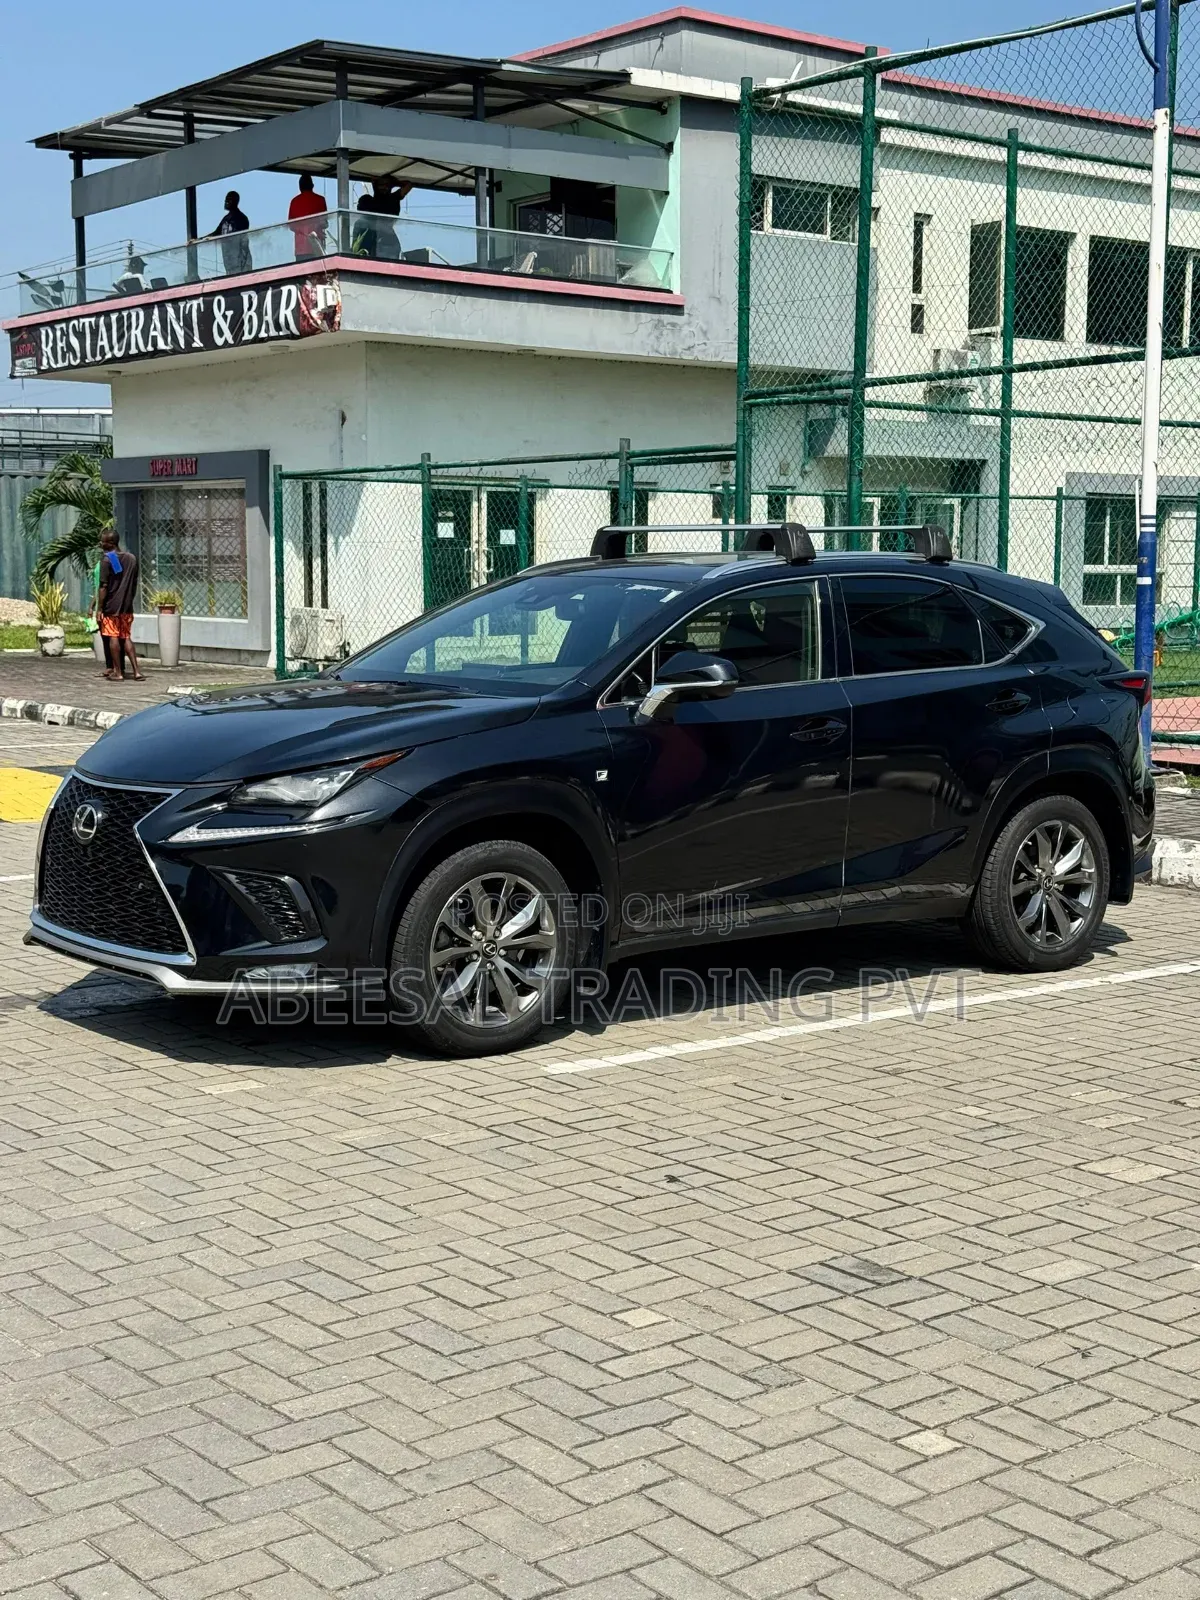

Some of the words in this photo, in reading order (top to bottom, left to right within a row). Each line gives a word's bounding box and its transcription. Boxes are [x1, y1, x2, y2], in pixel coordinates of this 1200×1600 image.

[40, 298, 204, 370] RESTAURANT
[212, 295, 235, 347] &
[240, 283, 300, 341] BAR
[149, 459, 173, 476] SUPER
[174, 457, 197, 475] MART
